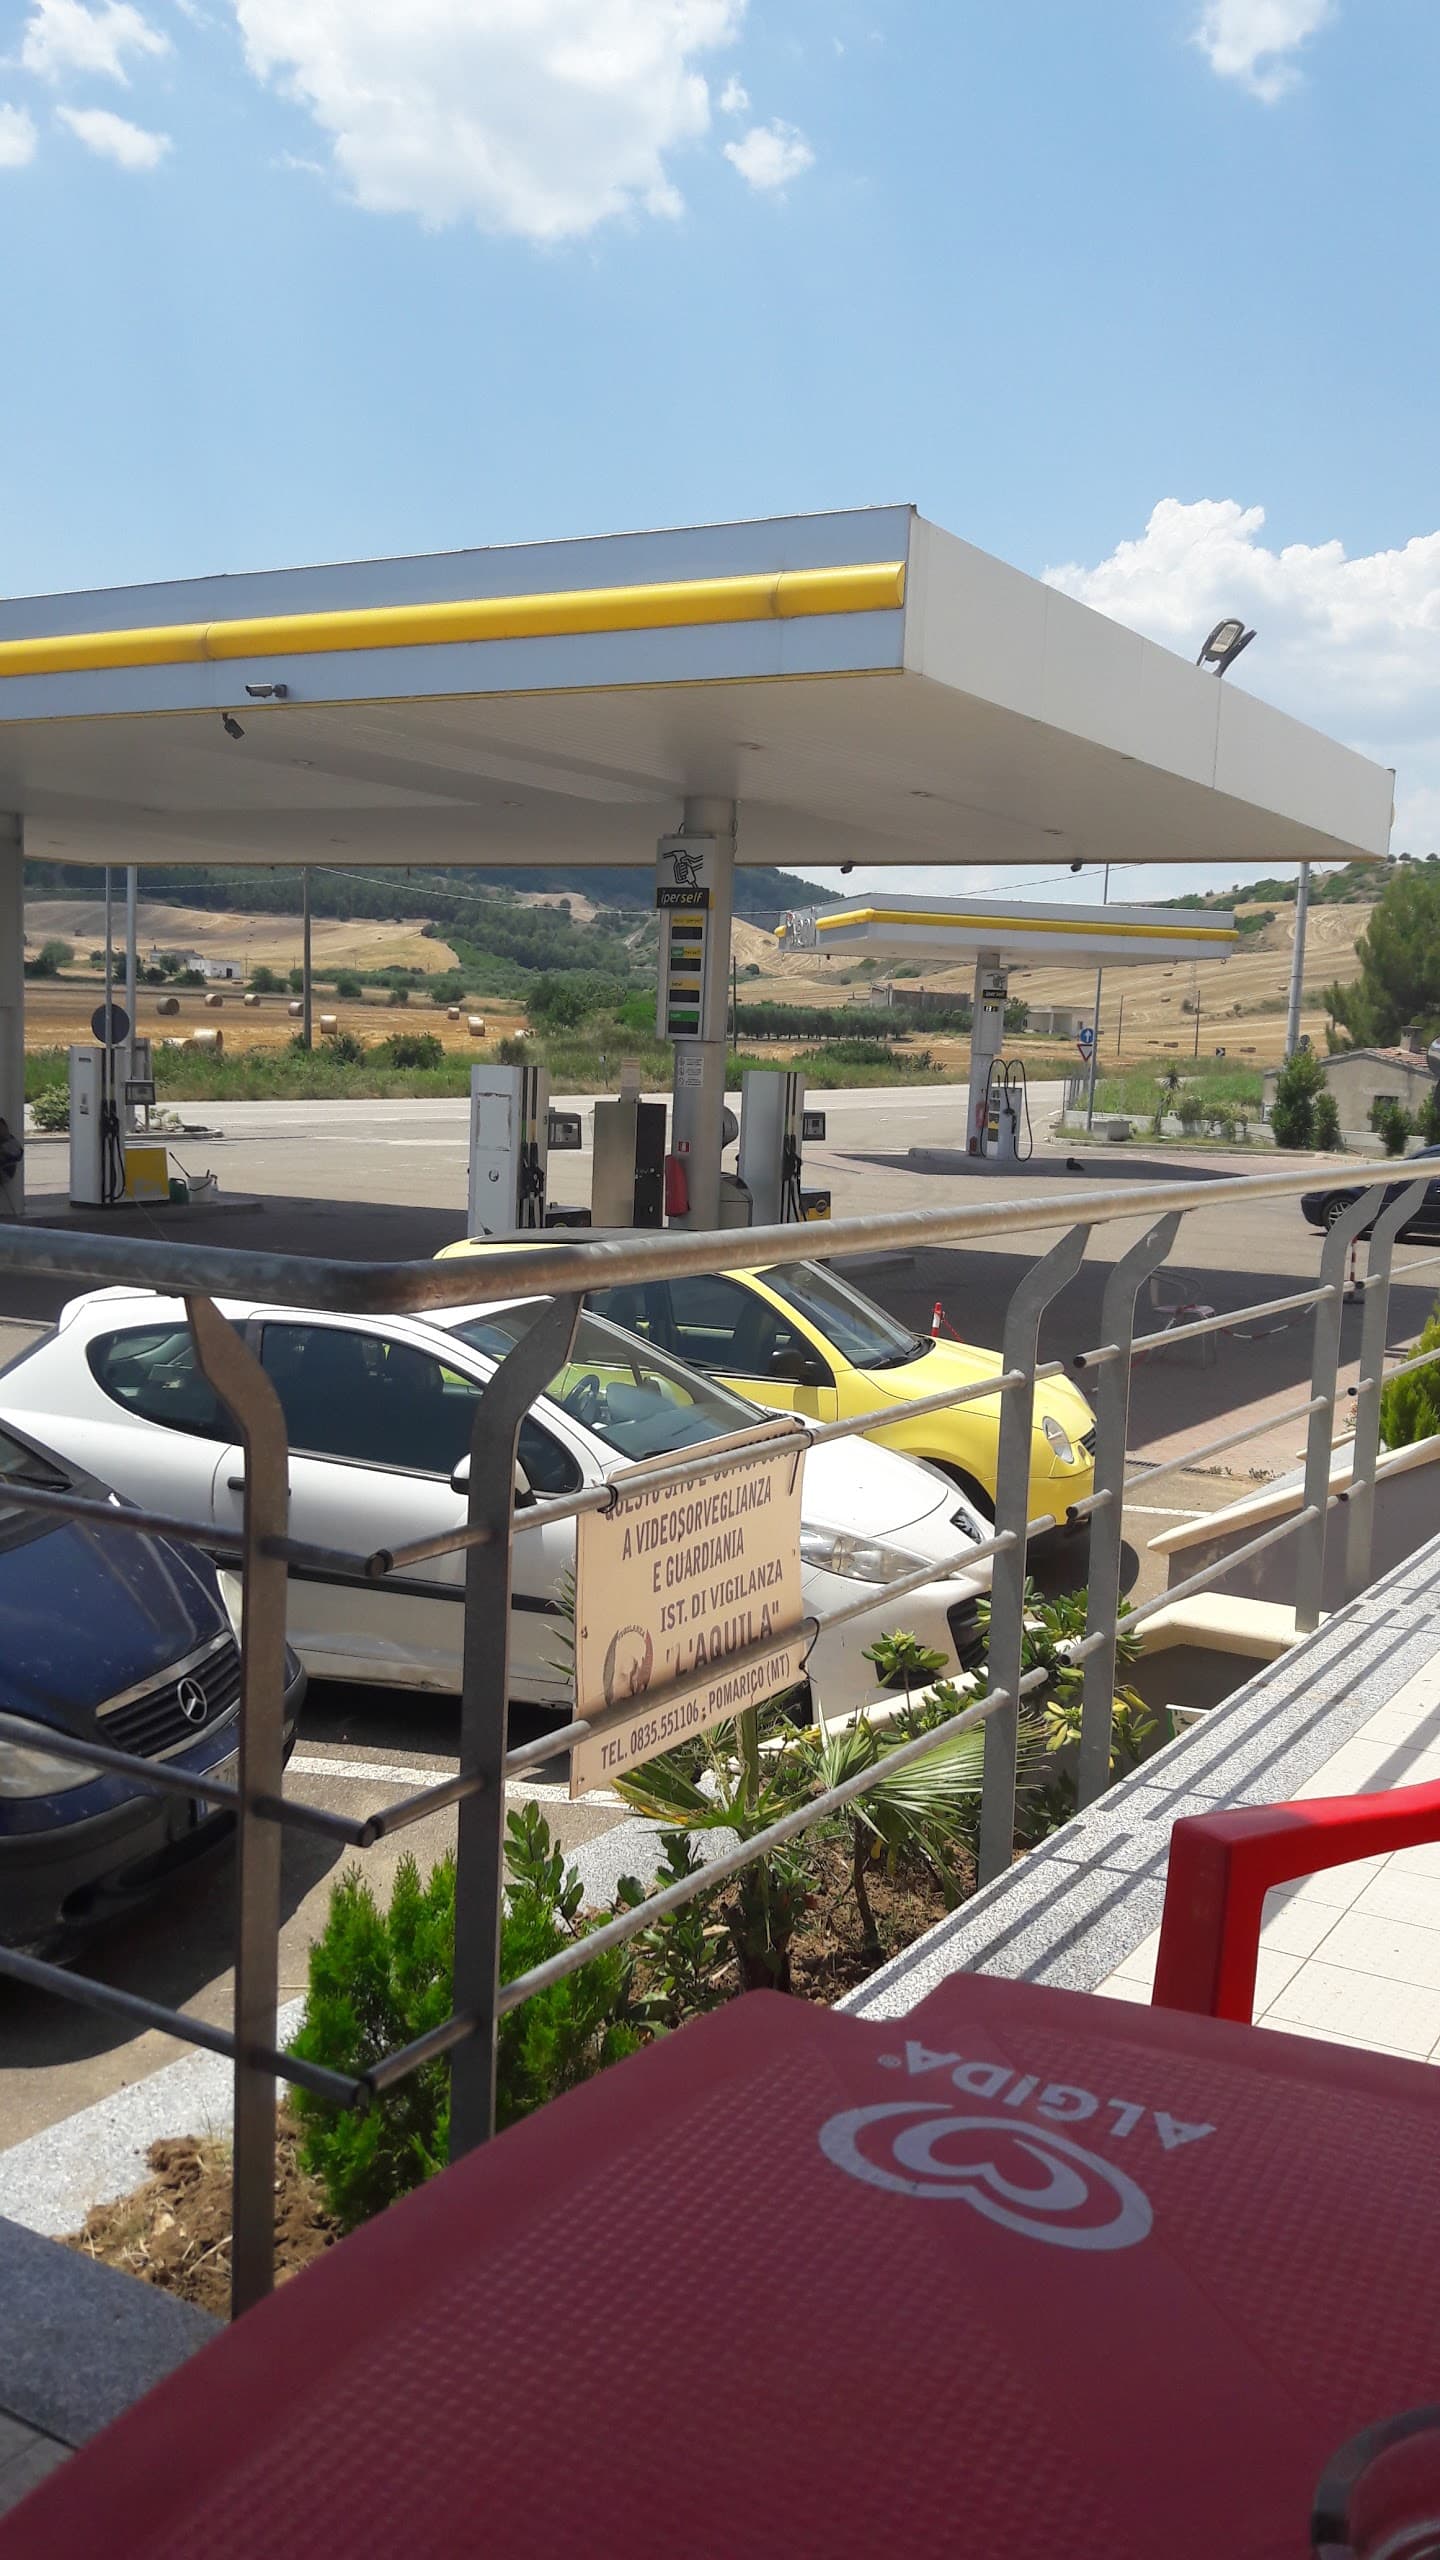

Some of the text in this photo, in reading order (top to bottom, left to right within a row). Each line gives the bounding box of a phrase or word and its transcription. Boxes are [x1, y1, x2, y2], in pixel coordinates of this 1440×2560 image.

[622, 1528, 632, 1561] A
[636, 1475, 771, 1554] VIDEOSORVEGLIANZA
[653, 1527, 744, 1593] E GUARDIANIA
[660, 1559, 783, 1633] IST. DI VIGILANZA
[601, 1738, 628, 1770] TEL.
[630, 1699, 699, 1755] 0835.551106
[708, 1665, 764, 1714] POMARICO
[766, 1652, 790, 1688] (MT)
[904, 2040, 1217, 2151] ALGIDA
